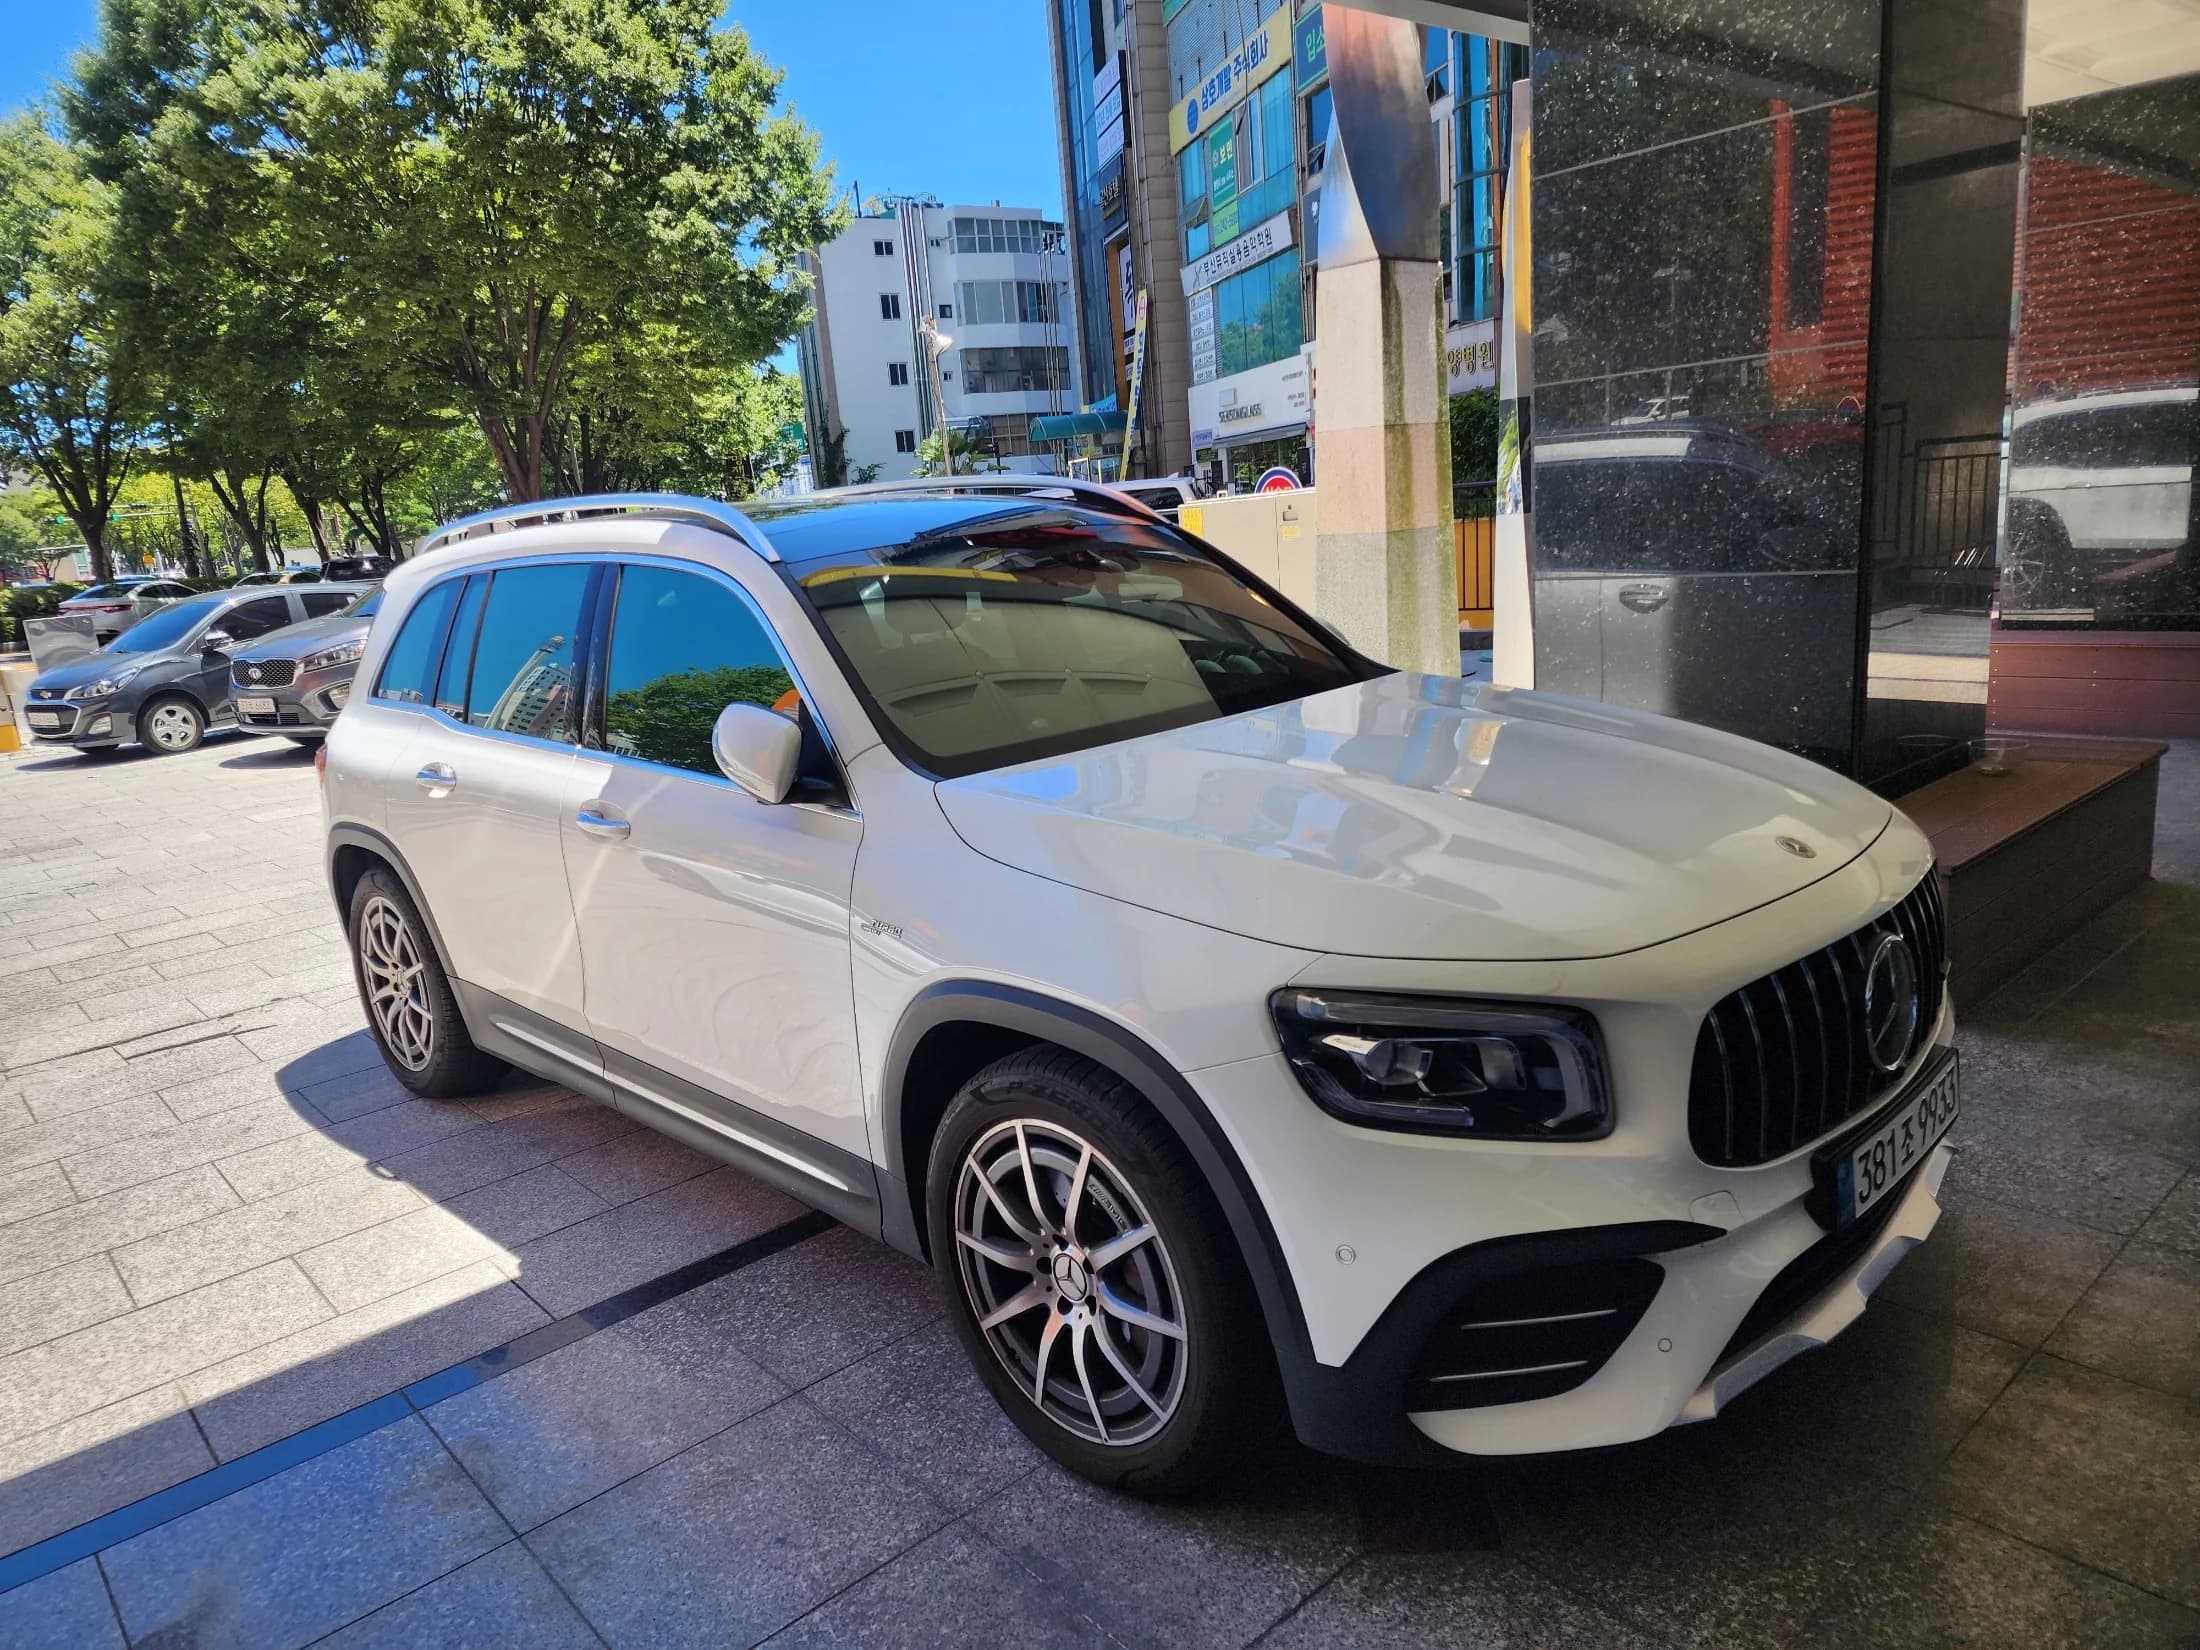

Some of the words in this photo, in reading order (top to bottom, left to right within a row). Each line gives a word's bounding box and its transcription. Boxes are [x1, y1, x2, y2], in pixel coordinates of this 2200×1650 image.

[1202, 64, 1232, 113] 삼호개발
[1234, 30, 1269, 83] 주식회사
[1858, 1114, 1915, 1204] 381조
[1918, 1065, 1956, 1148] 9933
